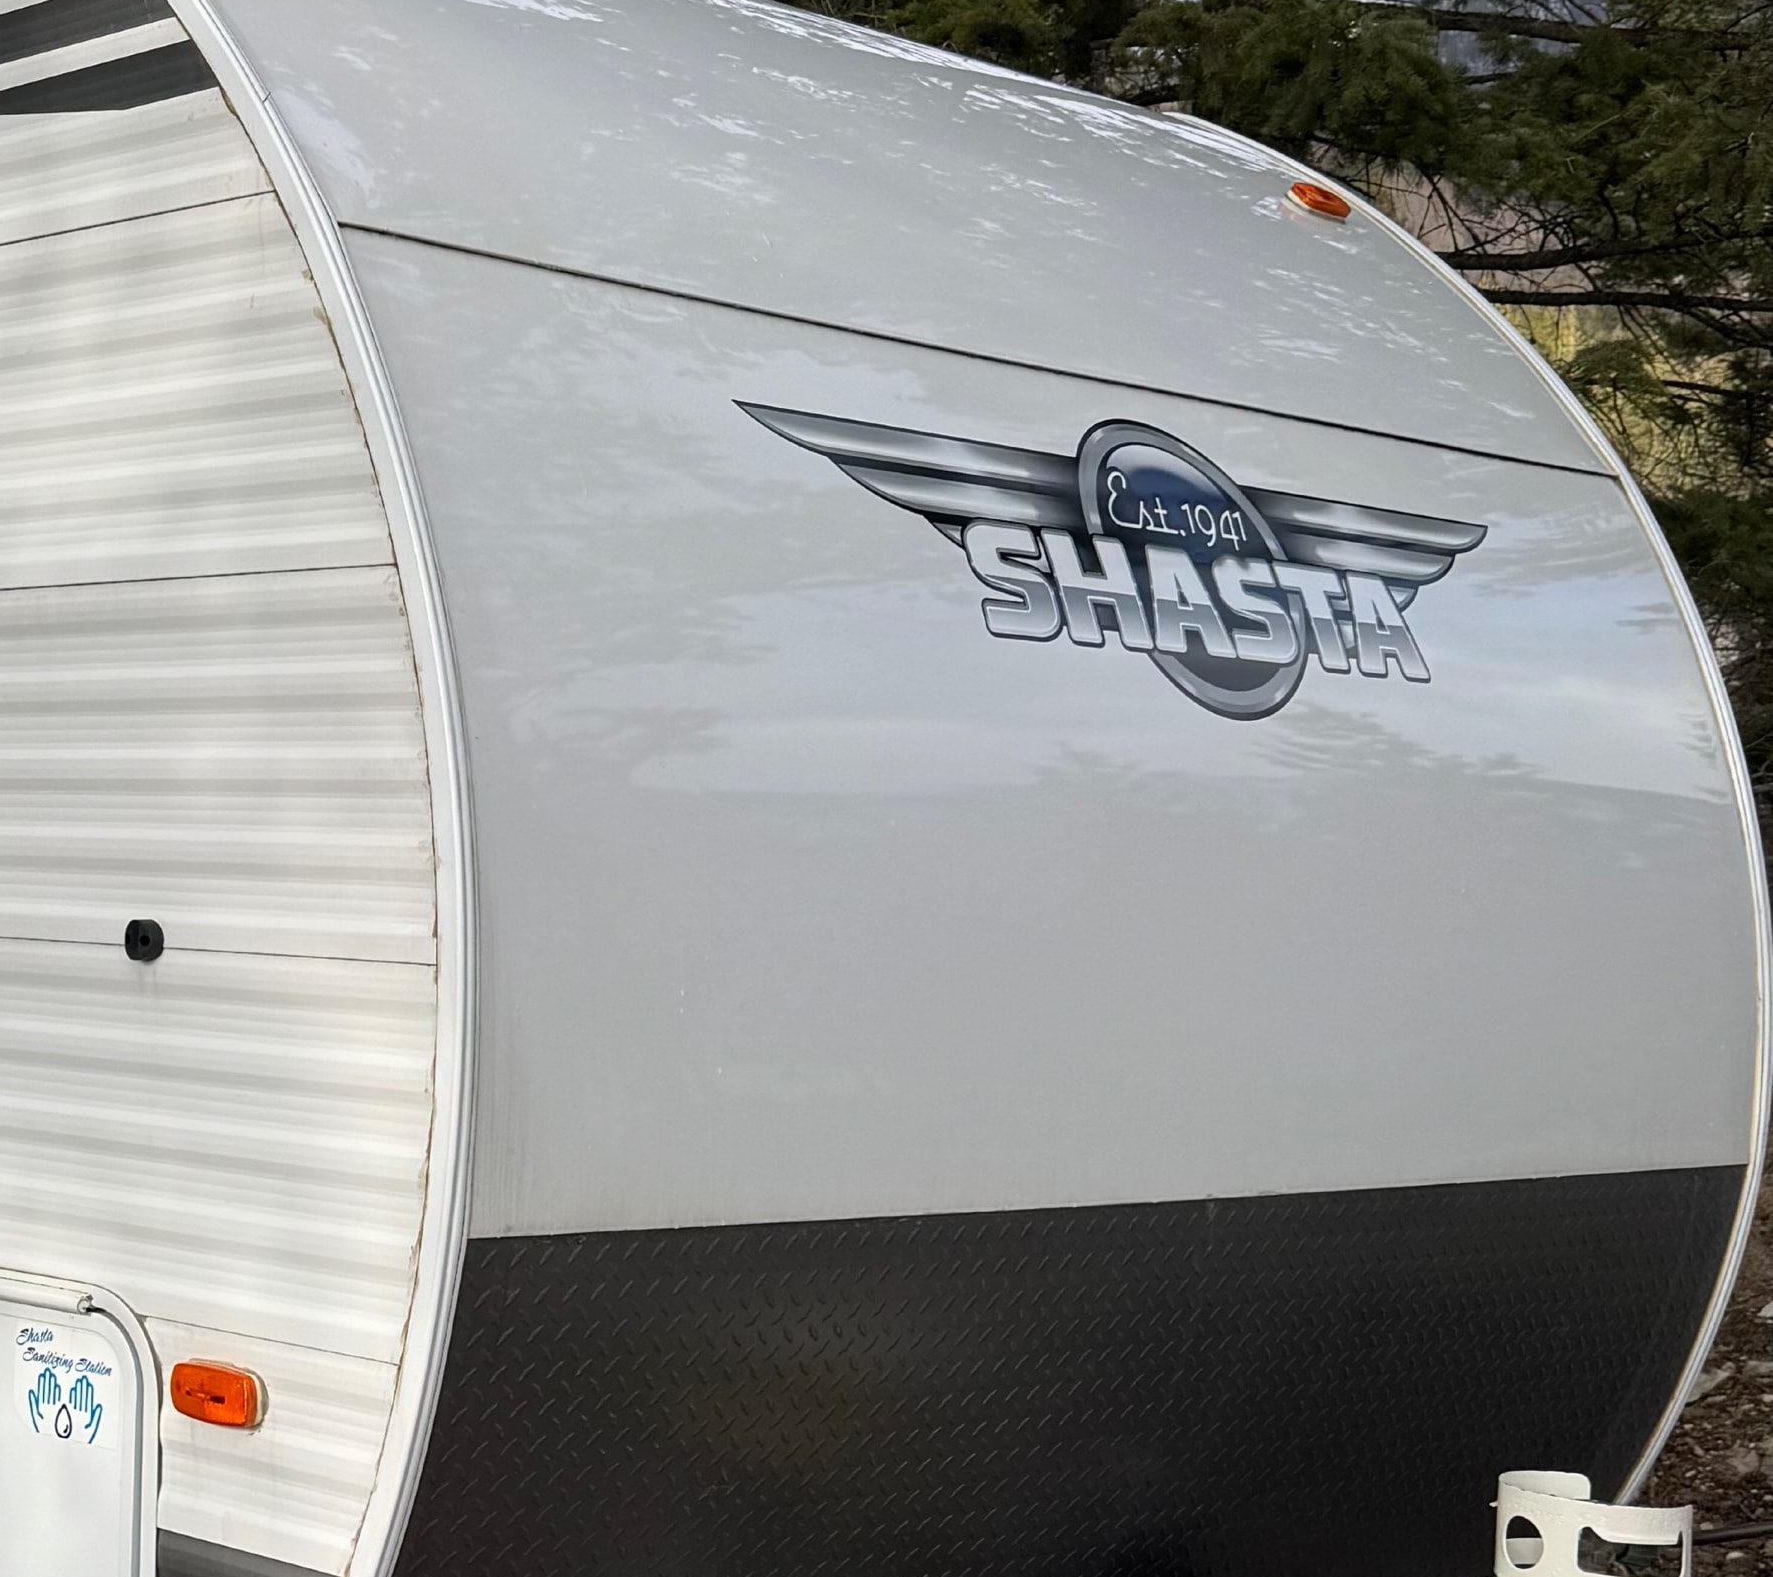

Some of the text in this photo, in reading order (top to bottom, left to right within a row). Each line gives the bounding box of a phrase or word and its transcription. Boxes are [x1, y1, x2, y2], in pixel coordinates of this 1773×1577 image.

[963, 519, 1432, 684] SHASTA
[16, 1327, 53, 1345] Shasta
[22, 1347, 112, 1377] Sanitizing Station
